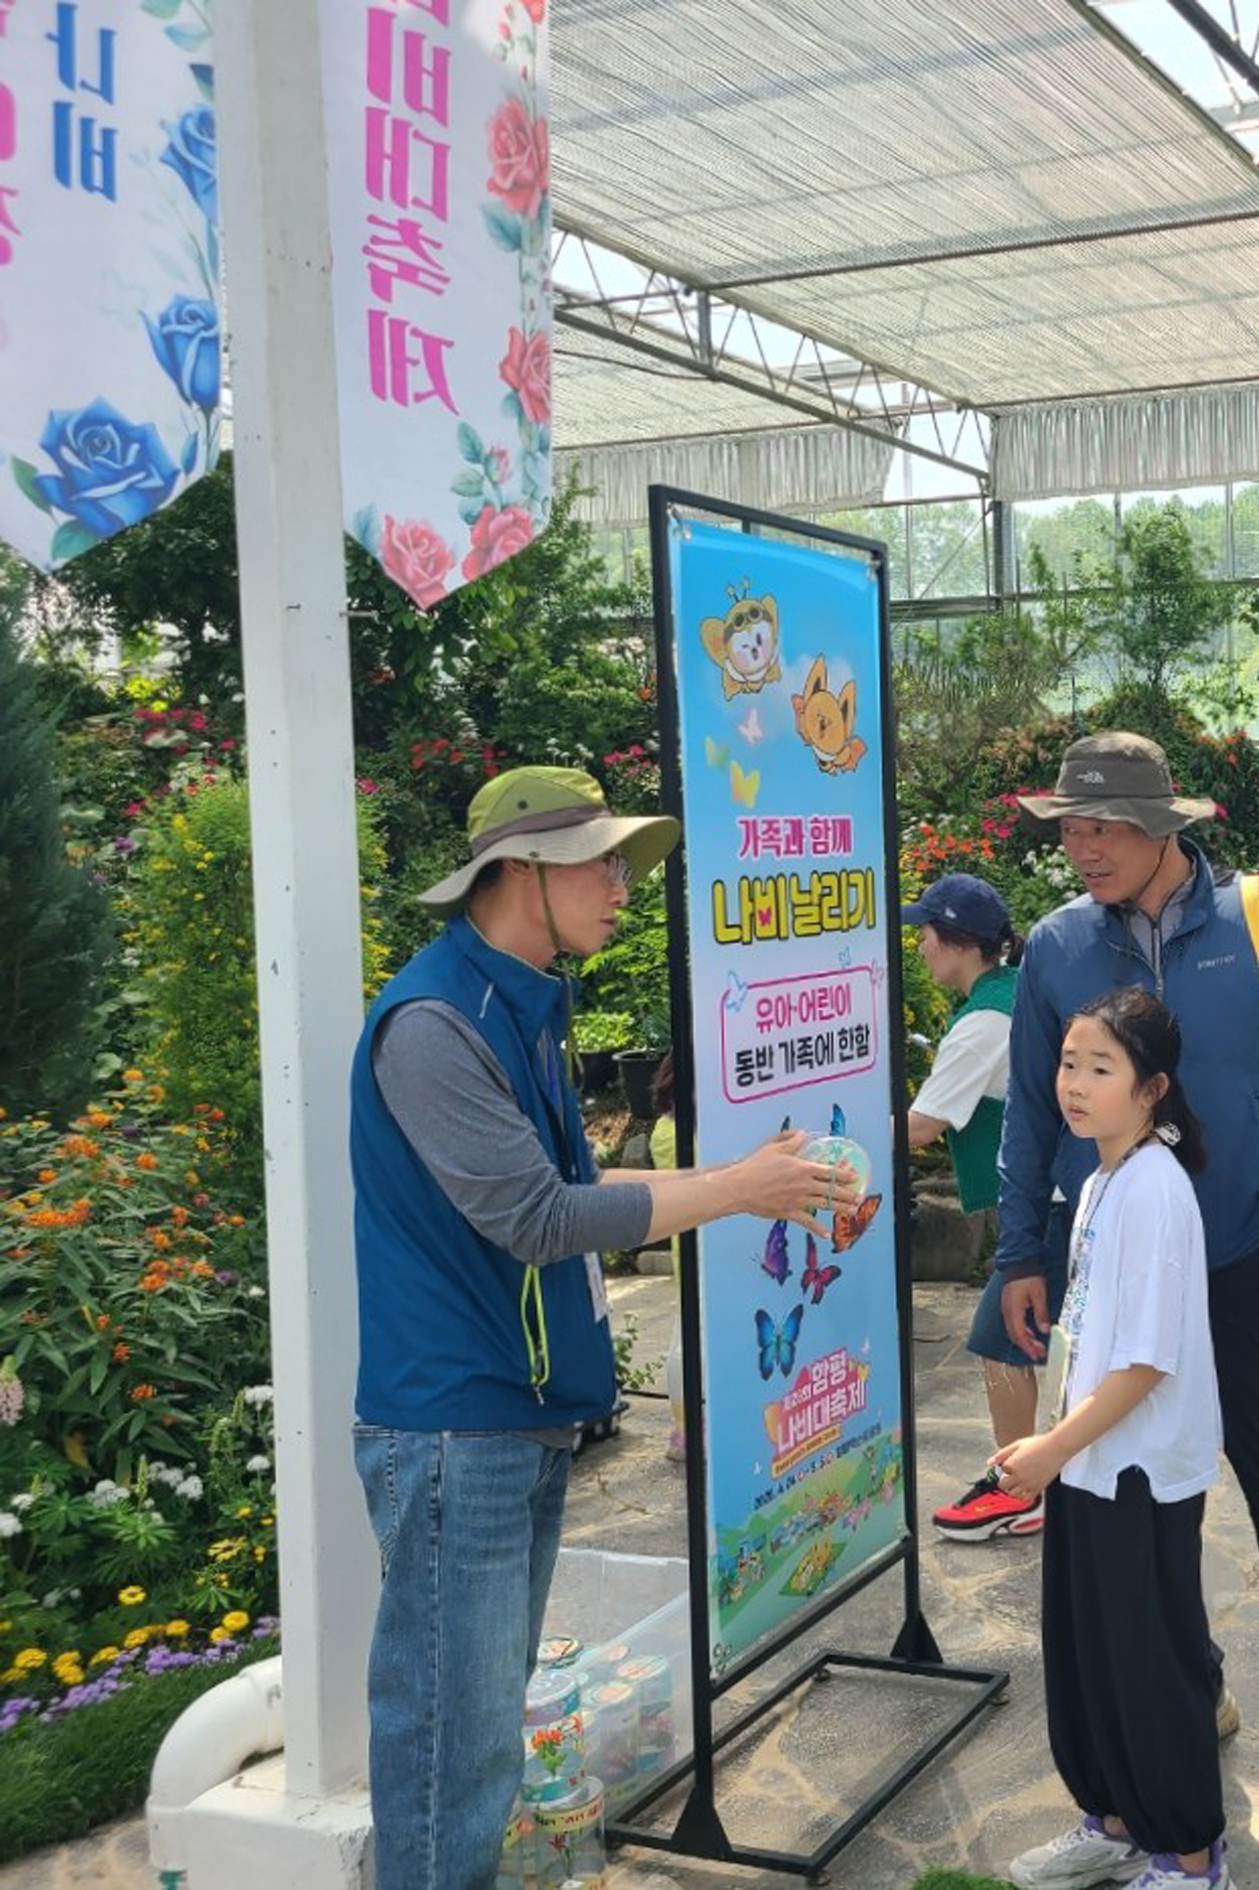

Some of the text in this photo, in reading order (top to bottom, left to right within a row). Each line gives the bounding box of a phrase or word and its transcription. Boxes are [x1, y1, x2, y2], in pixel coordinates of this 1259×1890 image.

[737, 816, 852, 859] 가족과 함께
[735, 1023, 870, 1088] 동반 가족에 한함
[777, 1379, 867, 1453] 나비대축제
